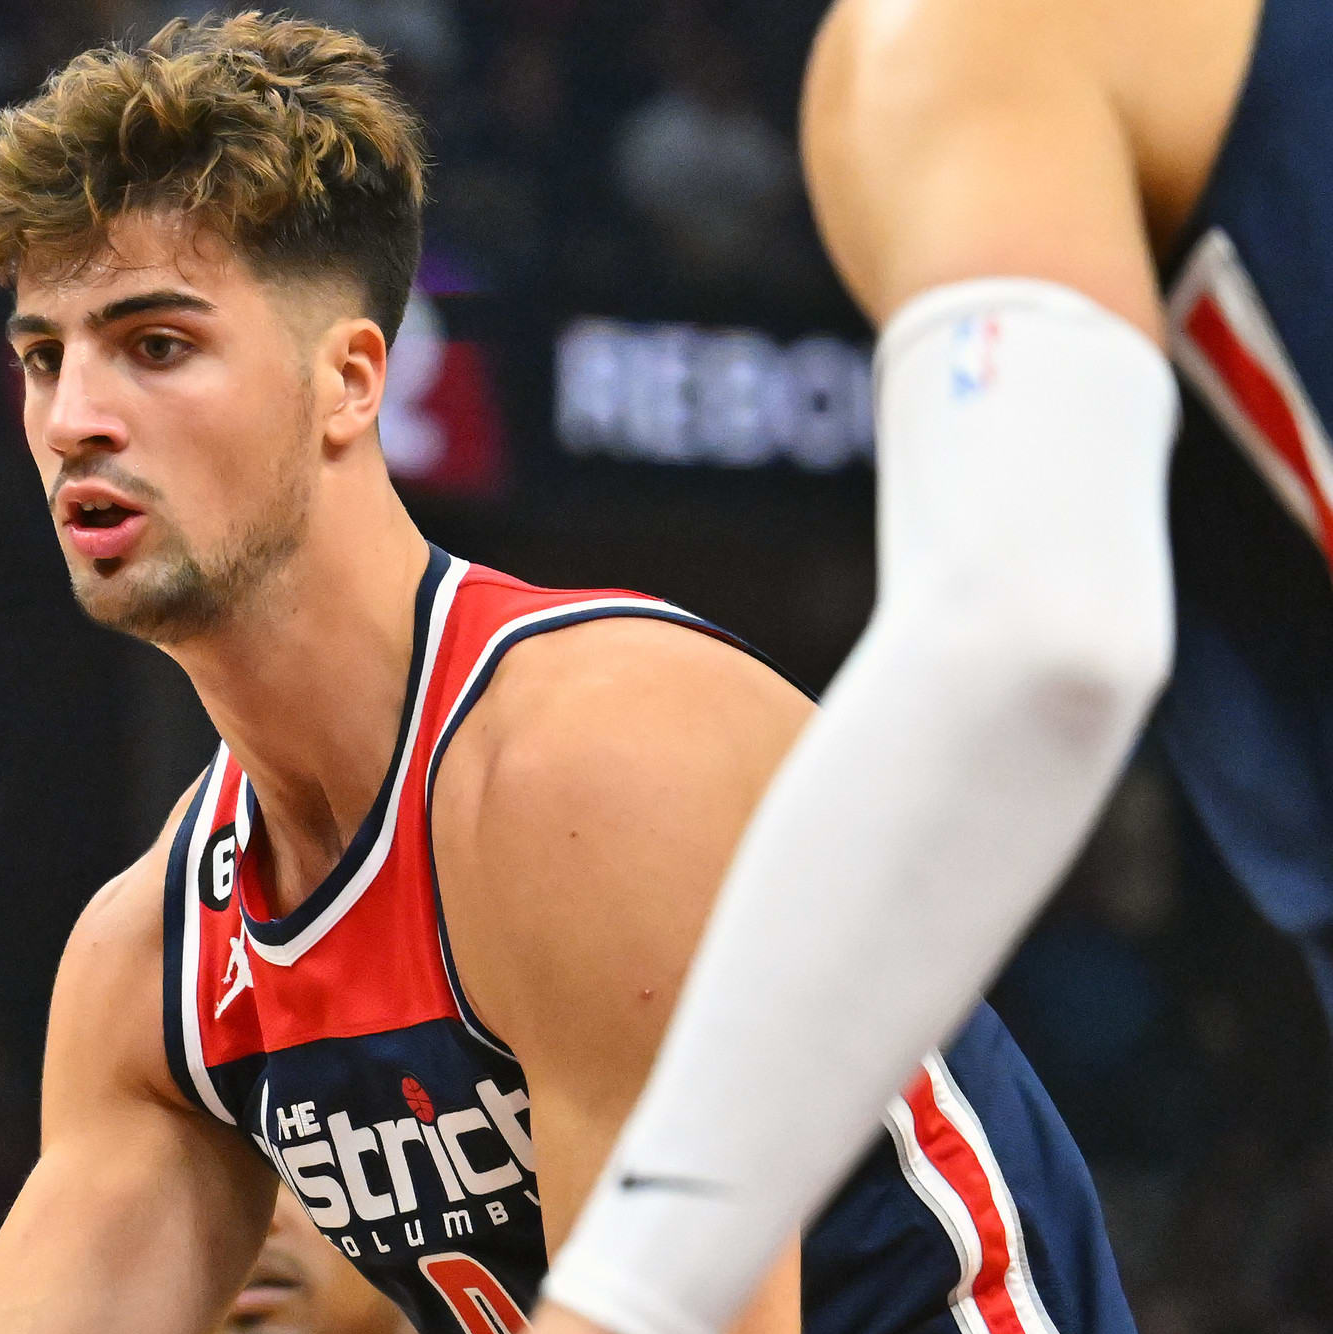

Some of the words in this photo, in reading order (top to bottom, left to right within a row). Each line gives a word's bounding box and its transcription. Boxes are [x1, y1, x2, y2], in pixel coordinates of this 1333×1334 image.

[213, 834, 236, 901] 6
[251, 1077, 537, 1230] strict
[275, 1099, 323, 1142] HE
[324, 1189, 541, 1258] OLUMB
